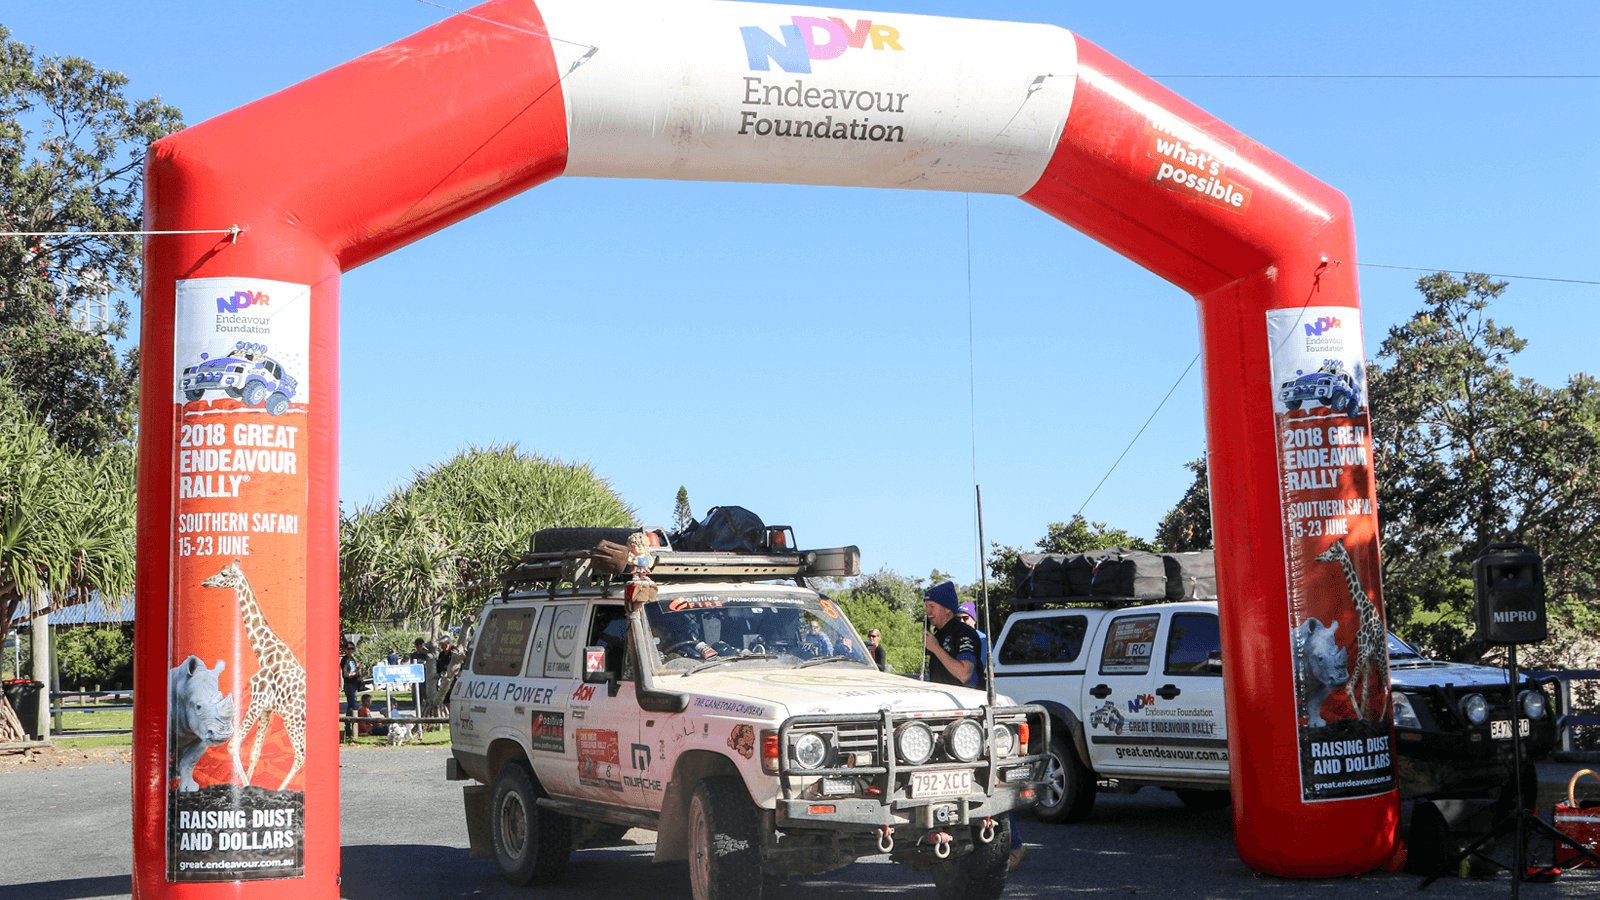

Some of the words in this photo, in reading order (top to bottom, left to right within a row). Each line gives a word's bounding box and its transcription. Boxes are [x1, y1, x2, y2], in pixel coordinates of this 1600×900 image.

[742, 76, 909, 113] Endeavour
[737, 110, 905, 143] Foundation
[1156, 138, 1221, 176] what's
[1156, 162, 1244, 207] possible
[215, 314, 271, 326] Endeavour
[215, 324, 271, 335] Foundation
[1305, 337, 1344, 345] Endeavour
[1306, 345, 1345, 353] Foundation
[180, 423, 226, 447] 2018
[233, 423, 298, 449] GREAT
[1284, 427, 1324, 449] 2018
[1328, 425, 1365, 446] GREAT
[180, 449, 297, 475] ENDEAVOUR
[1285, 447, 1368, 470] ENDEAVOUR
[1290, 499, 1346, 520] SOUTHERN
[1347, 498, 1373, 516] SAFARI
[179, 512, 248, 534] SOUTHERN
[252, 512, 298, 535] SAFARI
[1290, 520, 1323, 538] 15-23
[1325, 518, 1349, 536] JUNE
[179, 536, 214, 556] 15-23
[216, 535, 250, 556] JUNE
[688, 600, 724, 609] FIRE
[556, 625, 577, 640] CGU
[1131, 643, 1146, 656] RC
[465, 681, 501, 699] NOJA
[503, 682, 554, 705] POWER
[1145, 707, 1177, 717] Endeavour
[1177, 707, 1214, 717] Foundation
[541, 725, 564, 737] FIRE
[1128, 721, 1149, 733] GREAT
[1151, 721, 1191, 734] ENDEAVOUR
[1115, 746, 1229, 762] great.endeavour.com.a
[1311, 739, 1364, 758] RAISING
[1366, 735, 1389, 753] DUST
[1313, 759, 1341, 775] AND
[1345, 752, 1391, 773] DOLLARS
[1314, 775, 1392, 792] great.endeavour.com.au
[180, 810, 246, 830] RAISING
[252, 808, 295, 829] DUST
[180, 832, 213, 851] AND
[218, 830, 294, 851] DOLLARS
[179, 858, 295, 871] great.endeavour.com.au
